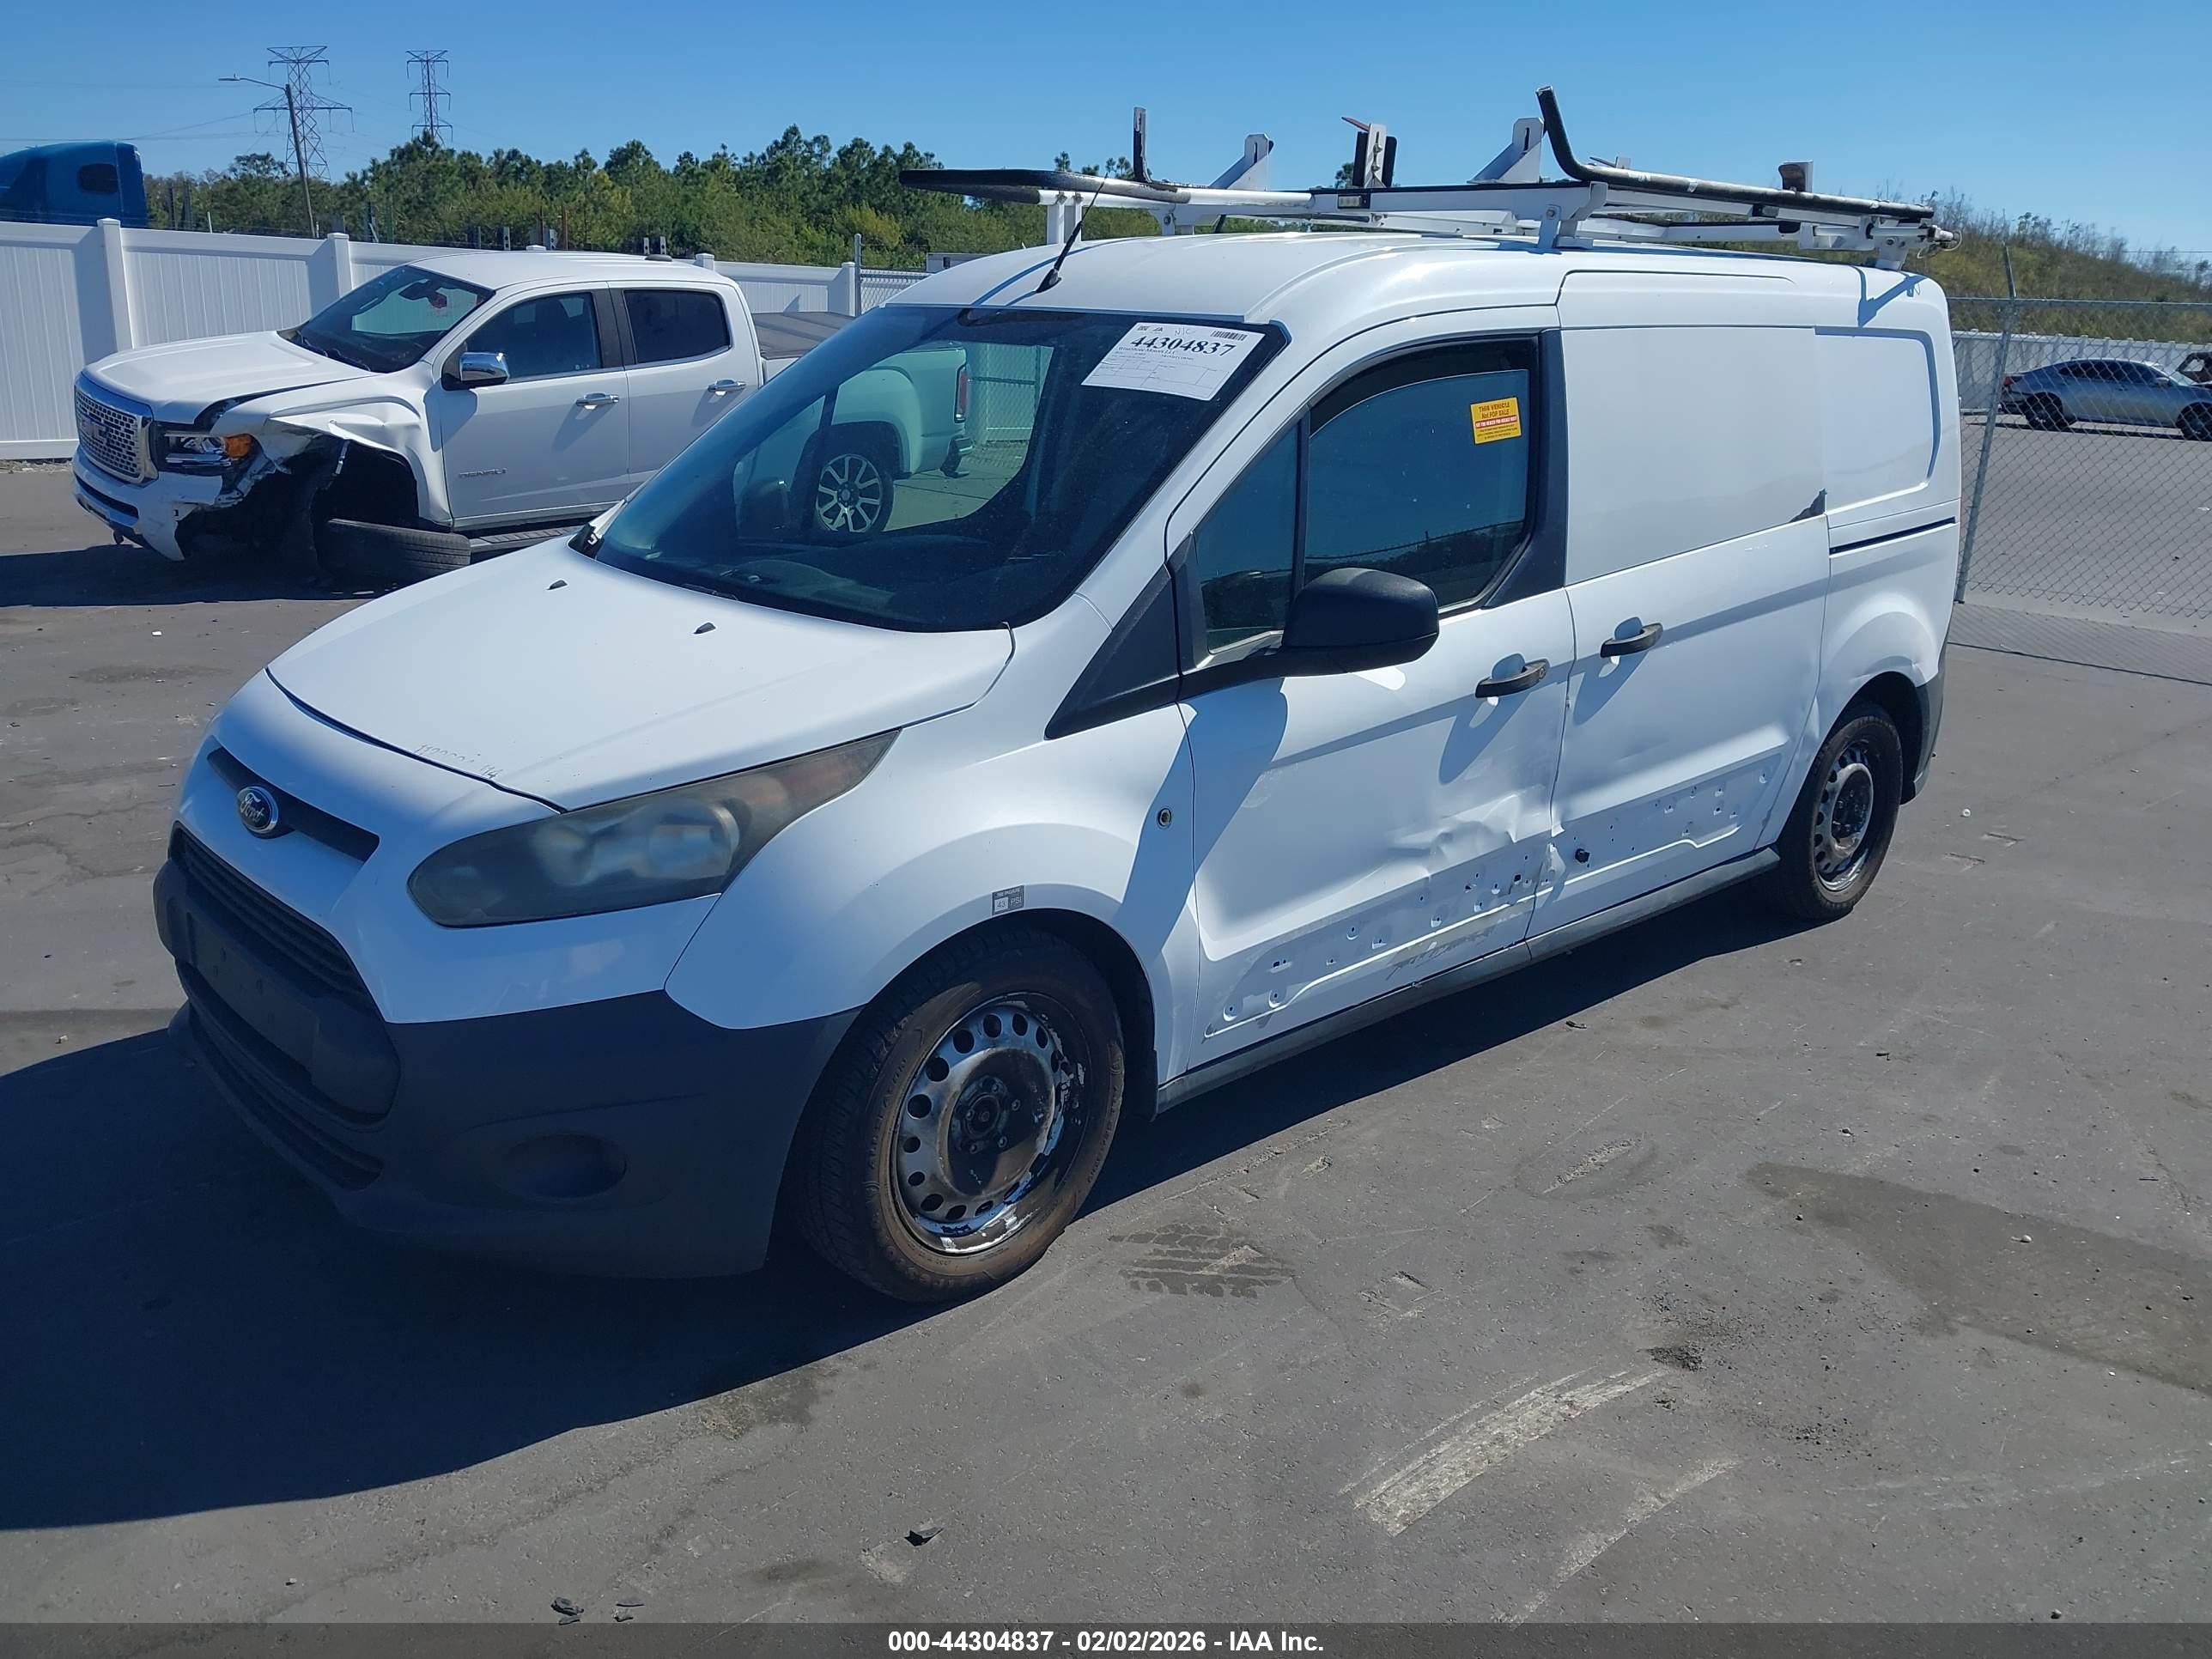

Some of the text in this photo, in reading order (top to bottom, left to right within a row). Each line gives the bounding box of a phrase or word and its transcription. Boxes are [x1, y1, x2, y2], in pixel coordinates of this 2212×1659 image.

[1130, 336, 1237, 356] 44304837
[240, 792, 265, 823] Ford
[1011, 896, 1022, 906] PSI
